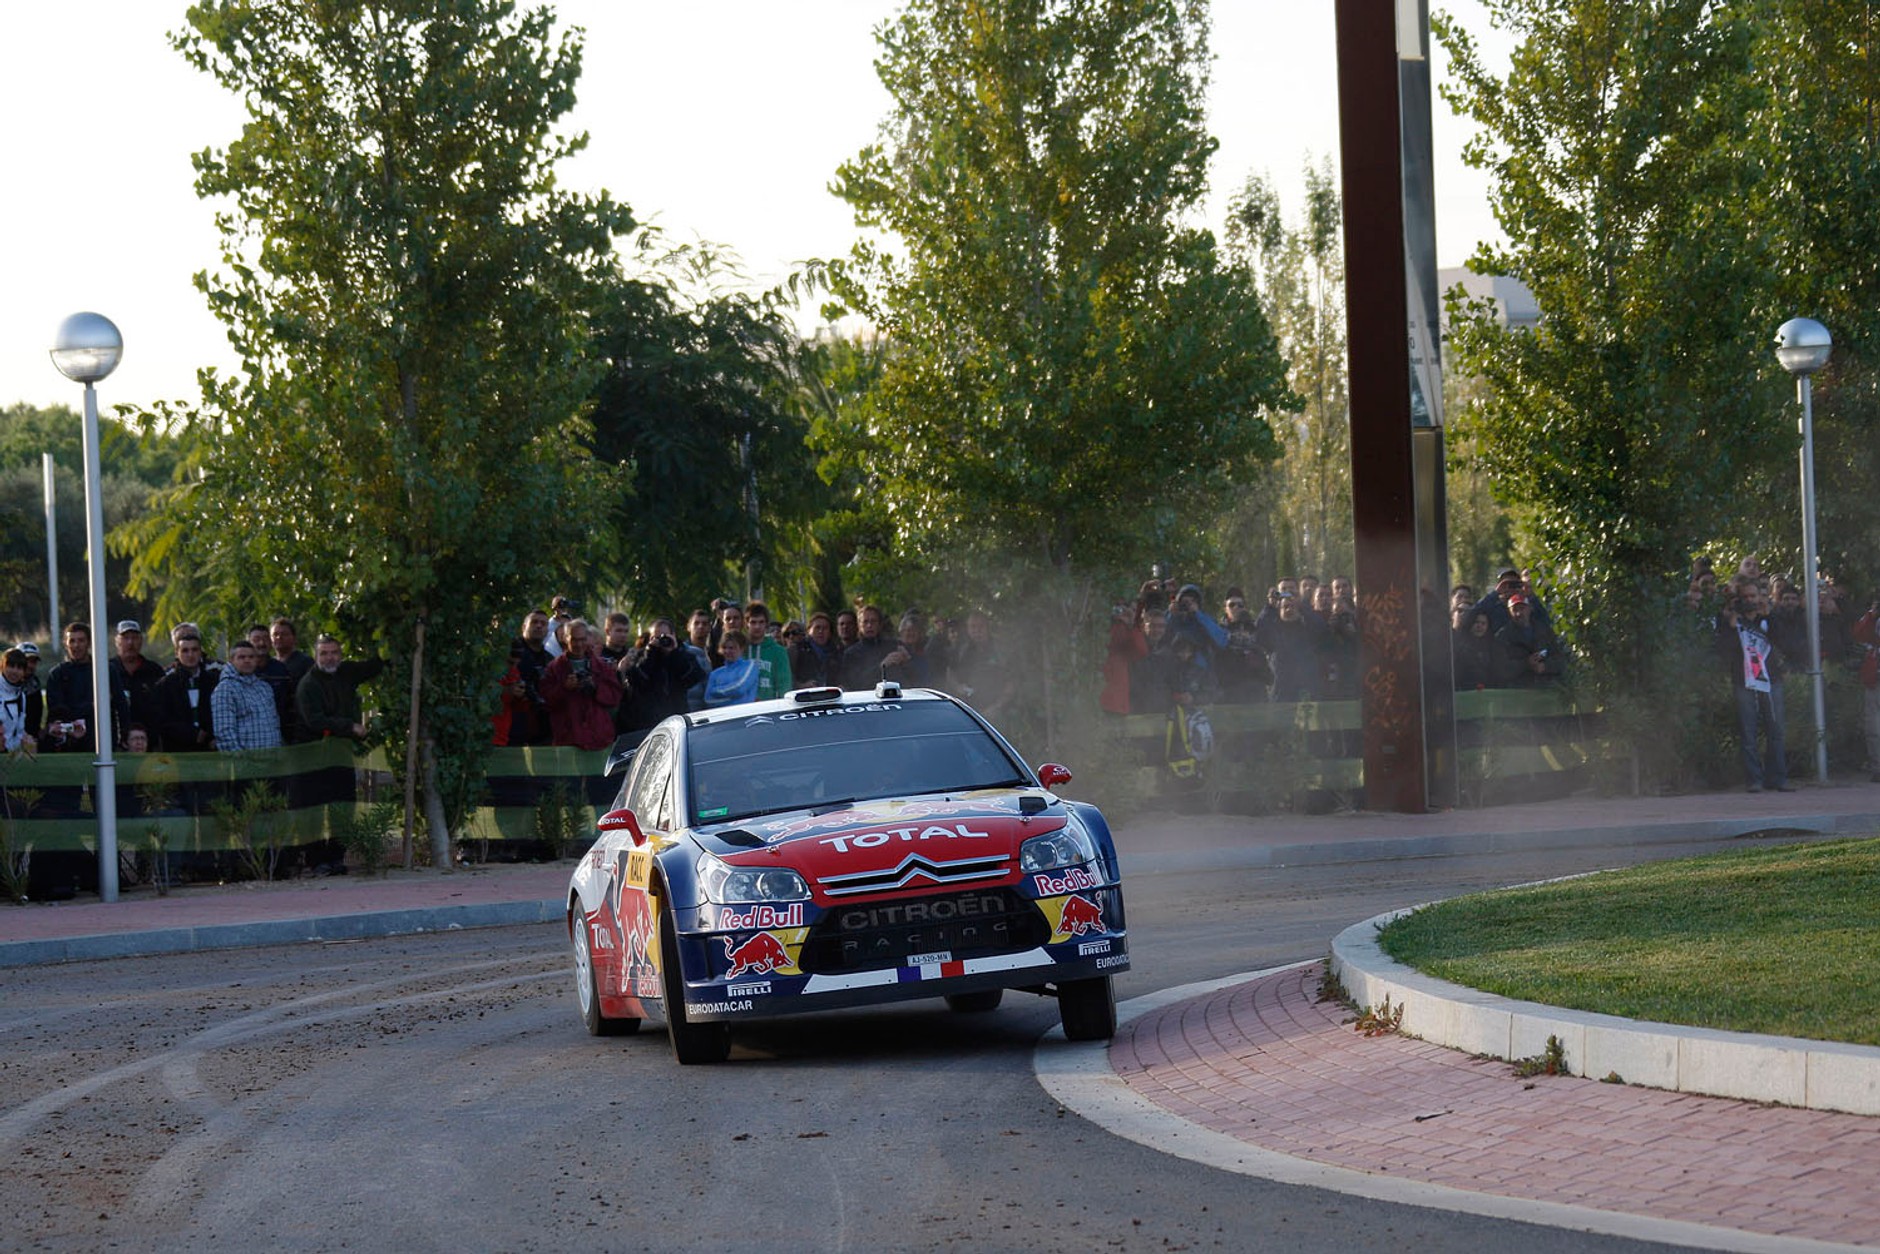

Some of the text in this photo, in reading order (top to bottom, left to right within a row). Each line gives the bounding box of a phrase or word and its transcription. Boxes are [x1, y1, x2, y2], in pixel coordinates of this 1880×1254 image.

[600, 816, 627, 824] TOTAL
[819, 824, 989, 853] TOTAL
[1033, 869, 1079, 897] Red
[719, 903, 804, 930] Red Bull
[841, 893, 1006, 930] CITROËN
[1078, 940, 1111, 956] PIRELLI
[727, 981, 772, 997] PIRELLI
[689, 1000, 753, 1015] EURODATACAR
